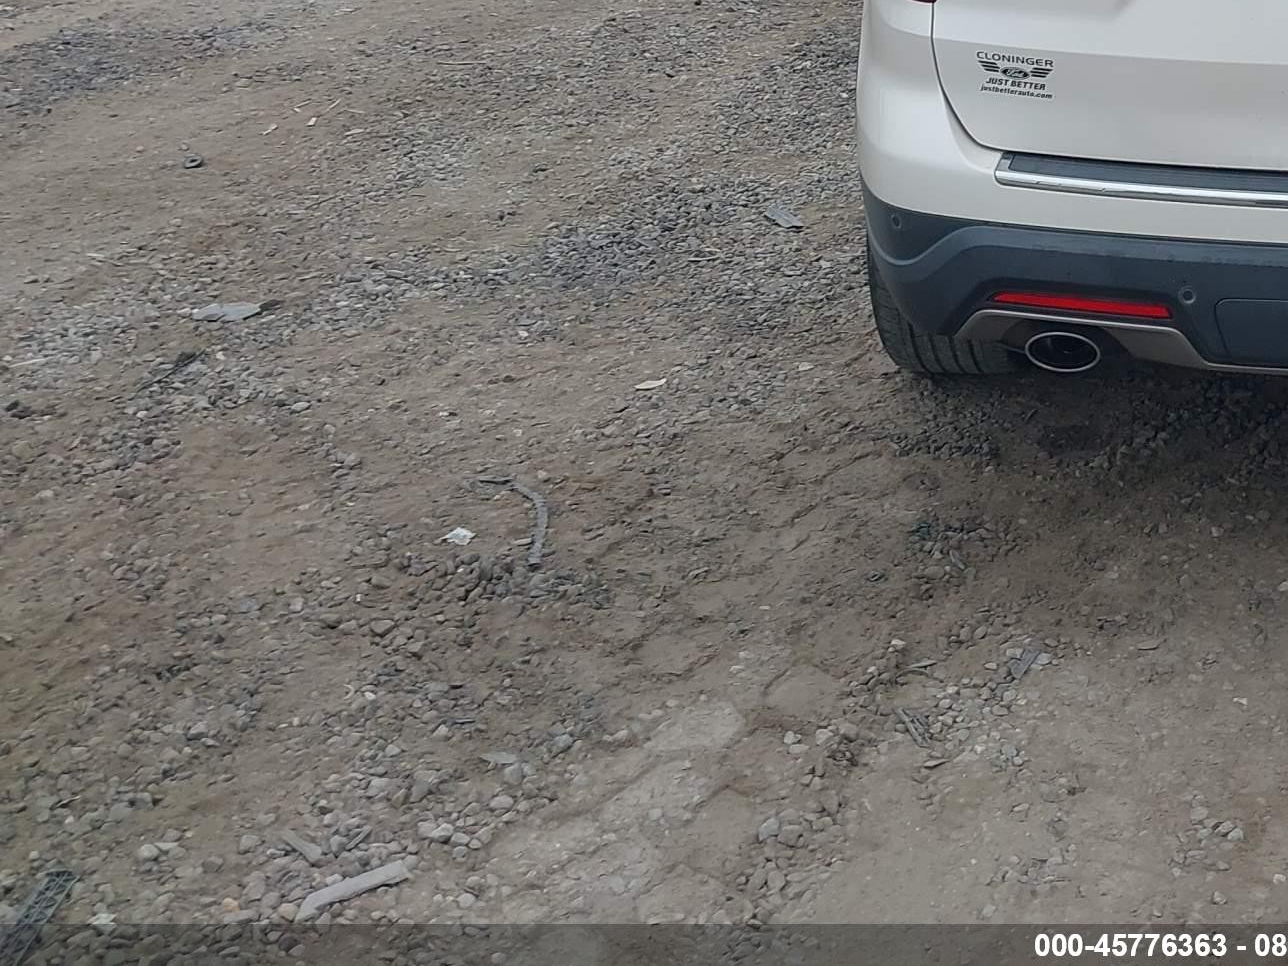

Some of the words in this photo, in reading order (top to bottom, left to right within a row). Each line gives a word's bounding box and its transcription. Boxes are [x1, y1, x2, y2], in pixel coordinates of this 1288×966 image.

[976, 51, 1054, 67] CLONINGER
[986, 77, 1010, 86] JUST
[1010, 80, 1046, 91] BETTER
